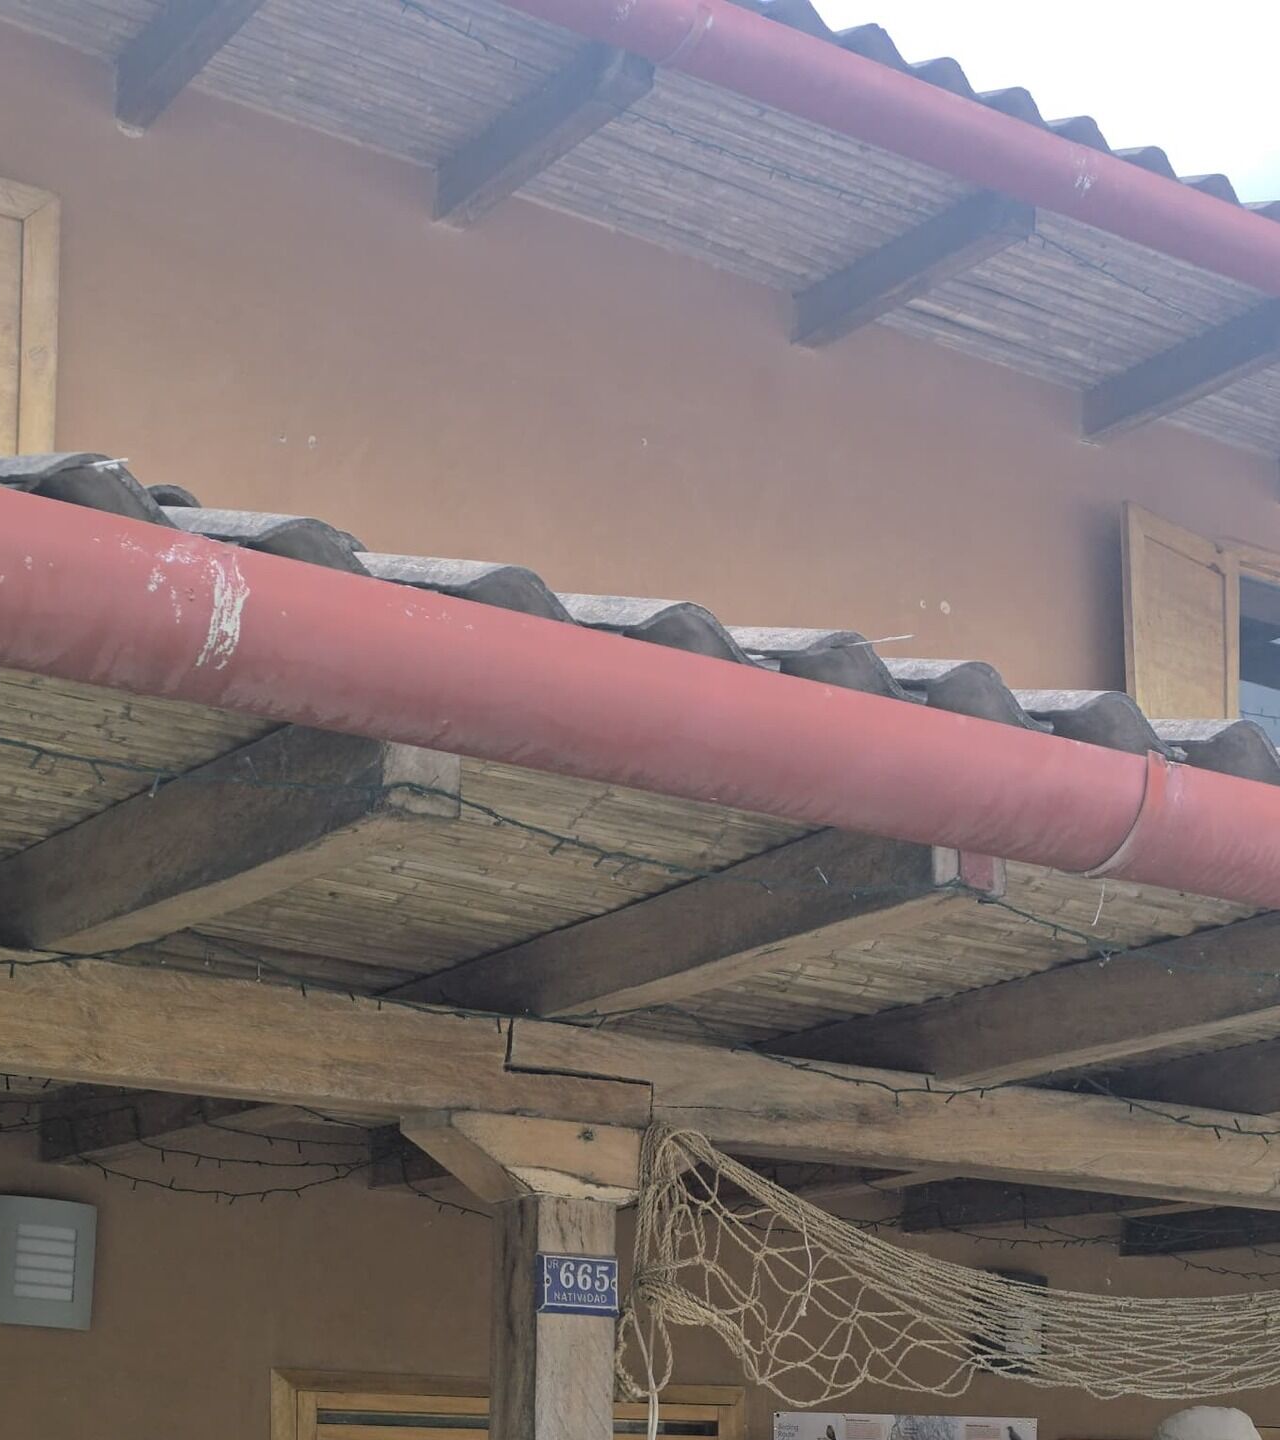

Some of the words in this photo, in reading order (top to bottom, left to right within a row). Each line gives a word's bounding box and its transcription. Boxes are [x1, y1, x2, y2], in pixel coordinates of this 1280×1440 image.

[548, 1259, 559, 1269] JR
[560, 1262, 609, 1292] 665
[554, 1291, 608, 1304] NATIVIDAD
